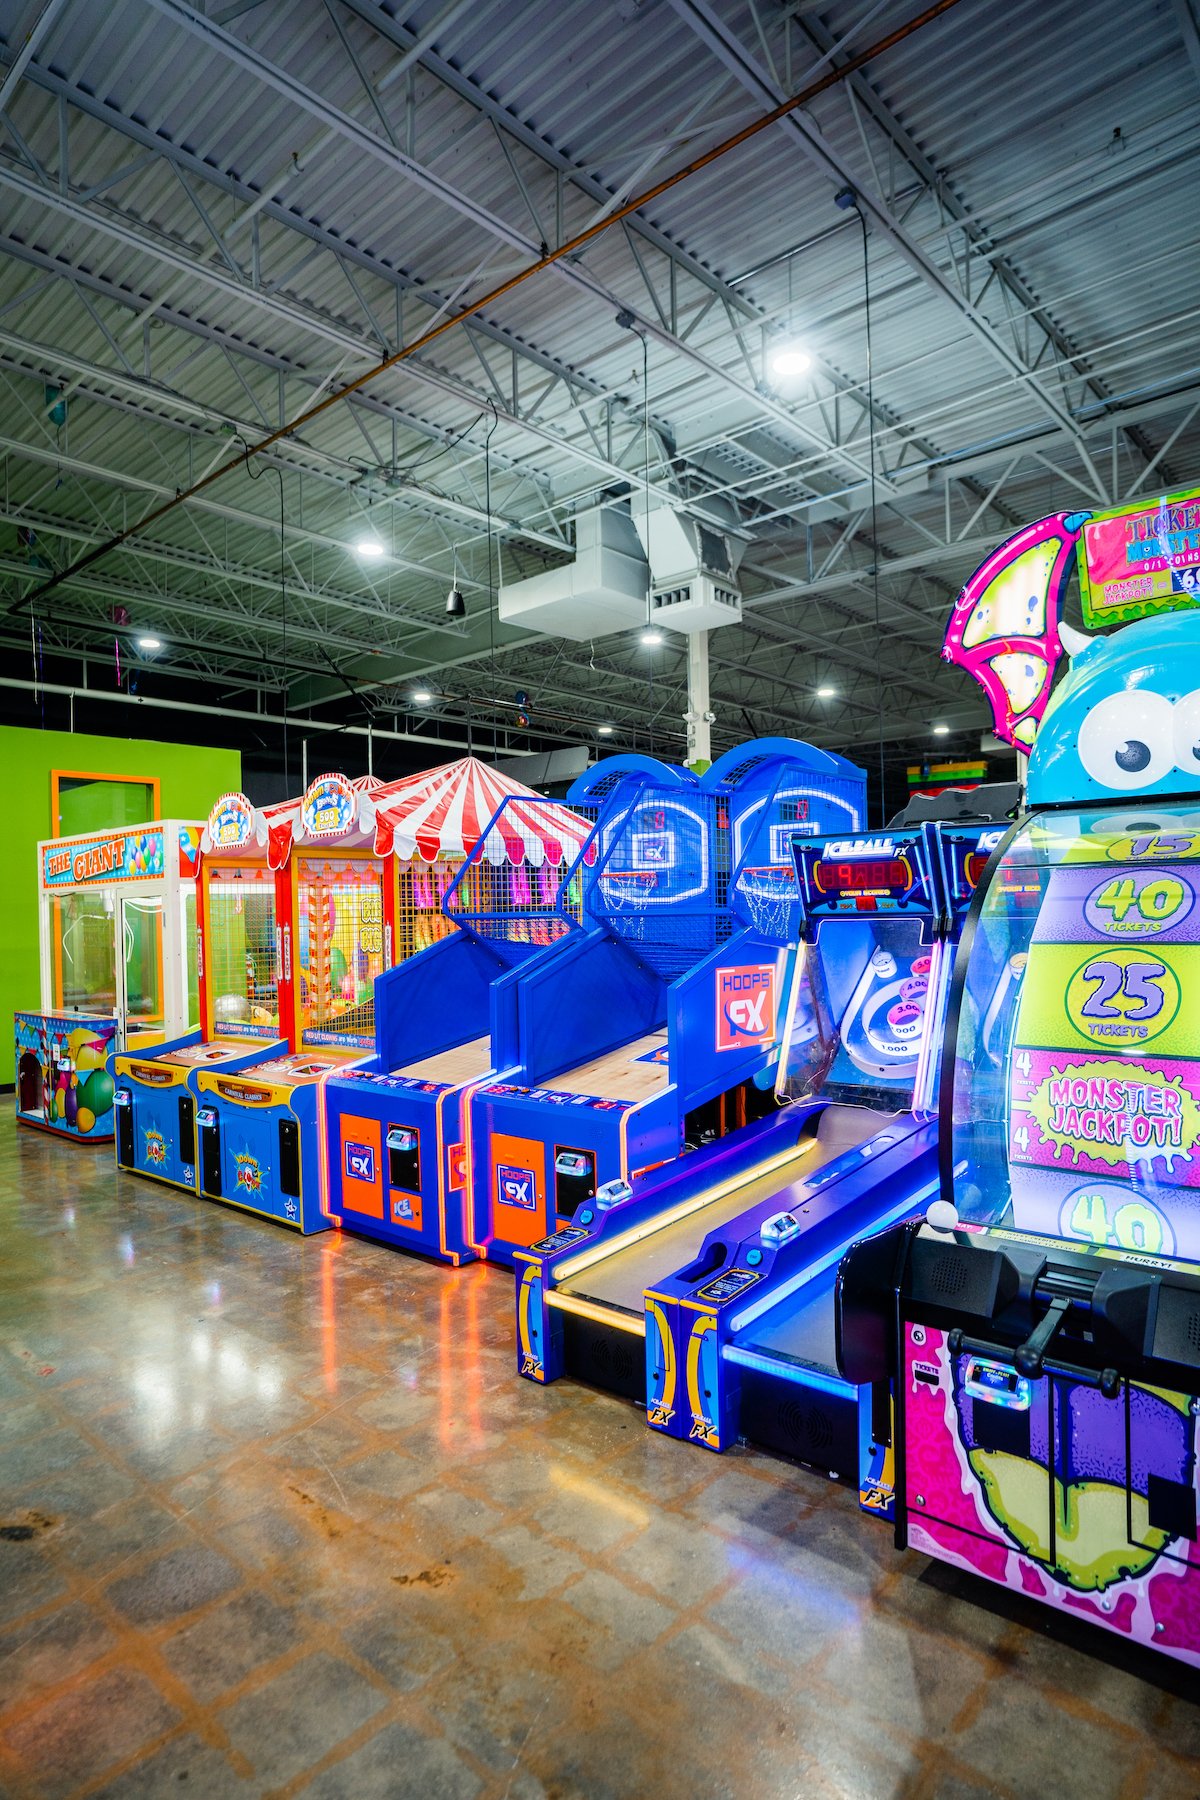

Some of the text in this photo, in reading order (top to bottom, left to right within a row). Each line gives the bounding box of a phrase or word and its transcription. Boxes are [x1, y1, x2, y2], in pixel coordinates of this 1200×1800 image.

[1126, 504, 1200, 541] TICKE
[1168, 554, 1199, 567] COINS
[1104, 577, 1153, 593] MONSTER
[1103, 587, 1153, 606] JACKPOT!
[320, 810, 335, 822] 500
[48, 837, 125, 881] THE GIANT
[1095, 879, 1184, 921] 40
[1104, 922, 1162, 932] TICKETS
[723, 972, 770, 992] HOOPS
[1080, 961, 1166, 1021] 25
[729, 991, 767, 1035] FX
[1088, 1023, 1148, 1037] TICKETS
[1015, 1052, 1033, 1077] 4
[1049, 1077, 1182, 1117] MONSTER
[1048, 1105, 1183, 1147] JACKPOT!
[1014, 1126, 1031, 1153] 4
[348, 1147, 371, 1157] HOOPS
[501, 1170, 531, 1182] HOOPS
[394, 1198, 413, 1218] ICE
[1070, 1195, 1164, 1254] 40
[1125, 1255, 1172, 1269] HURRY!
[521, 1360, 543, 1375] FX
[915, 1362, 939, 1375] TICKETS
[650, 1408, 676, 1427] FX
[689, 1422, 717, 1441] FX
[862, 1488, 895, 1511] FX
